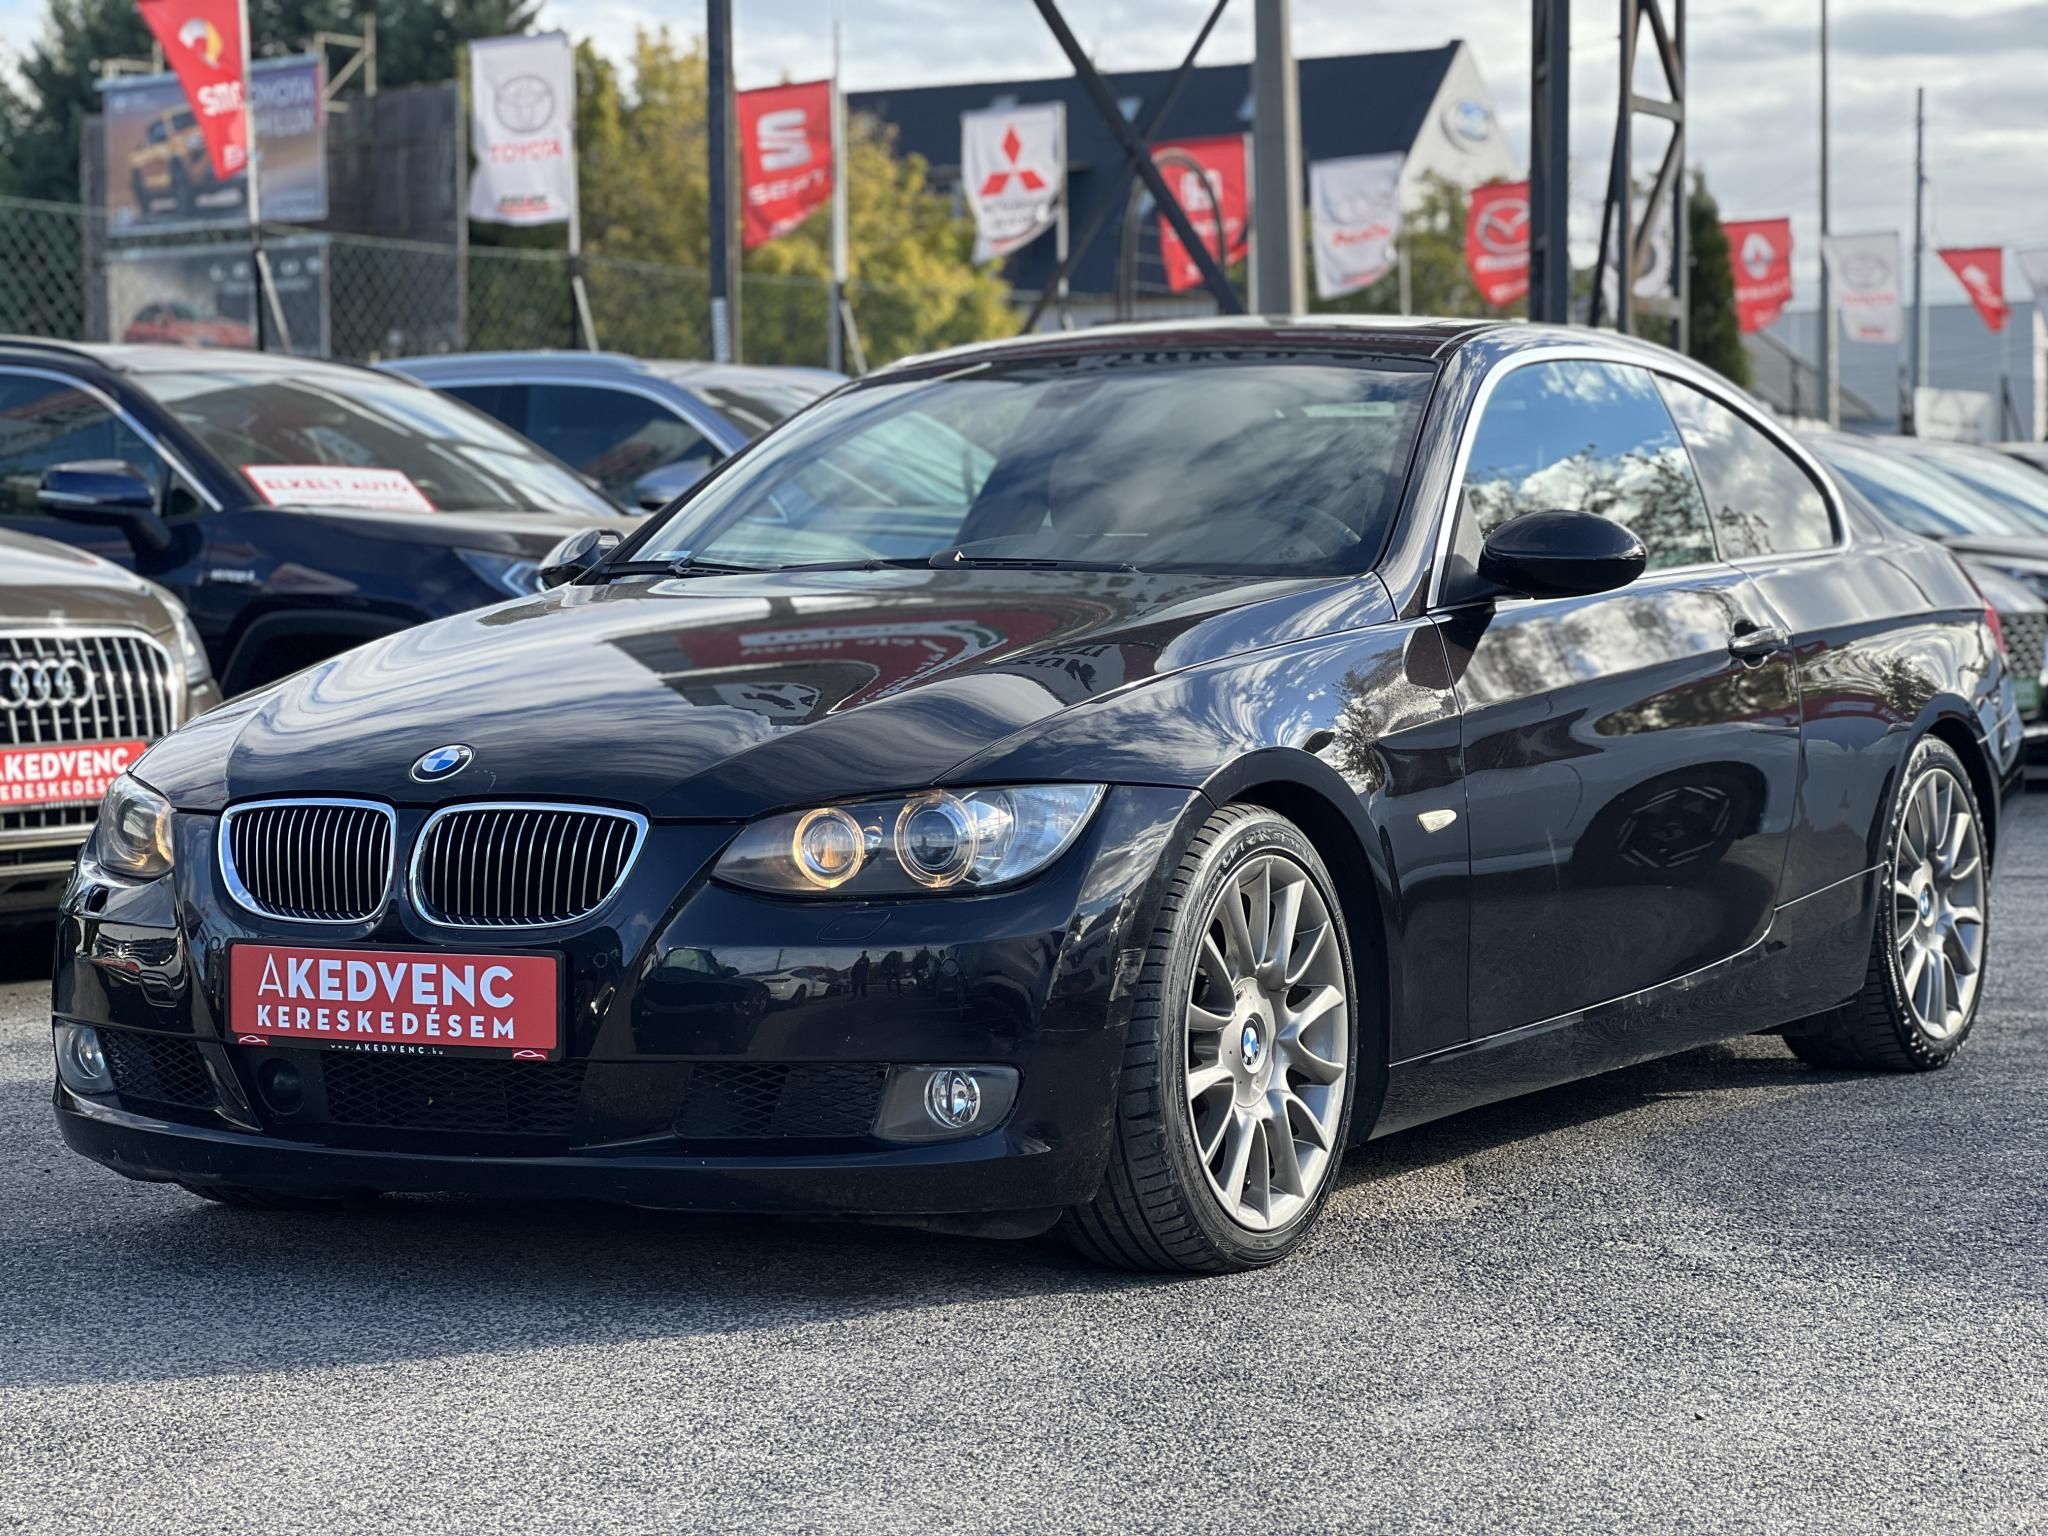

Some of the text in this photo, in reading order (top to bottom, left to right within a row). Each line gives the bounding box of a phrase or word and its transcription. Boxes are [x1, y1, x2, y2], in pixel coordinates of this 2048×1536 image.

[489, 140, 563, 164] TOYOTA
[0, 747, 129, 783] KEDVENC
[0, 774, 114, 802] ERESKEDÉS
[256, 952, 515, 1009] AKEDVENC
[256, 1004, 515, 1040] KERESKEDÉSEM
[330, 1043, 444, 1056] www.AKEDVENC.hu
